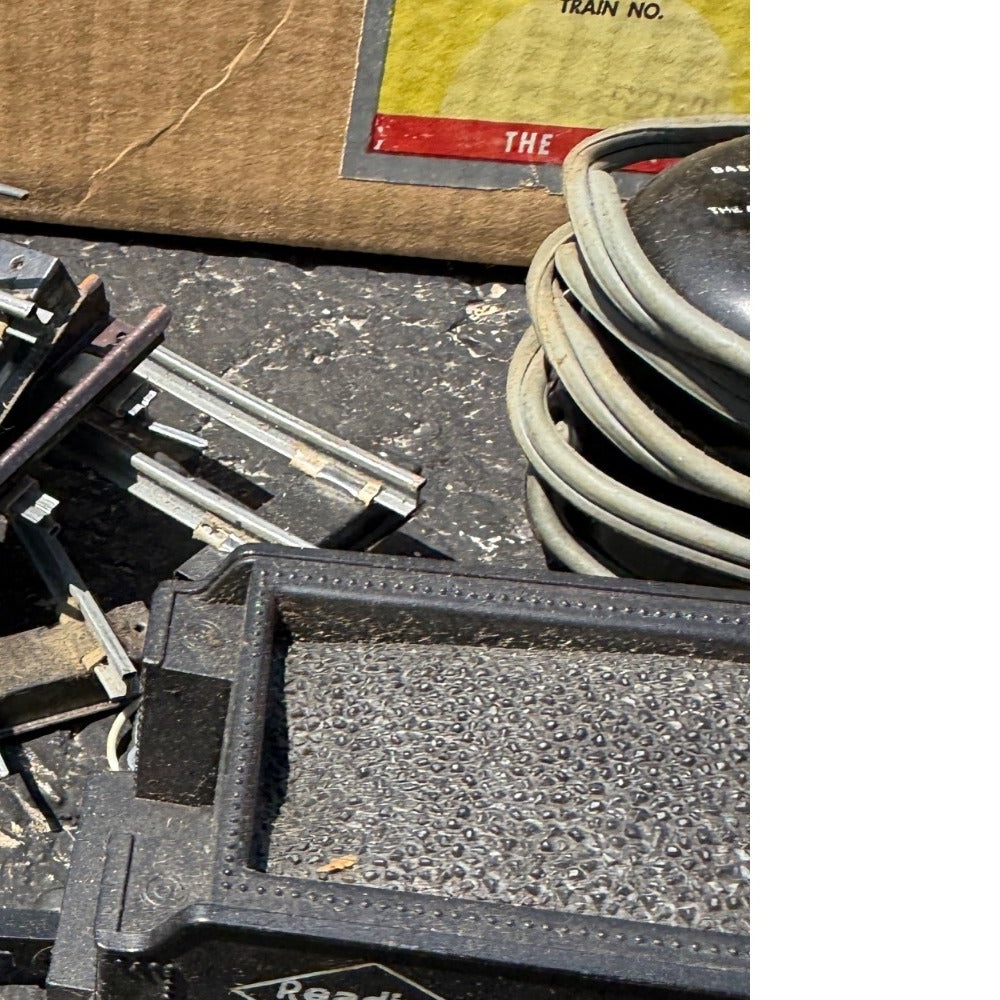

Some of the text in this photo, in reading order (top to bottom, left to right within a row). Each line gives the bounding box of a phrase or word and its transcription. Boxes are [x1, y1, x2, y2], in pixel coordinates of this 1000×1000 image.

[561, 0, 664, 20] TRAIN NO.
[505, 131, 554, 156] THE
[711, 165, 750, 174] BAS
